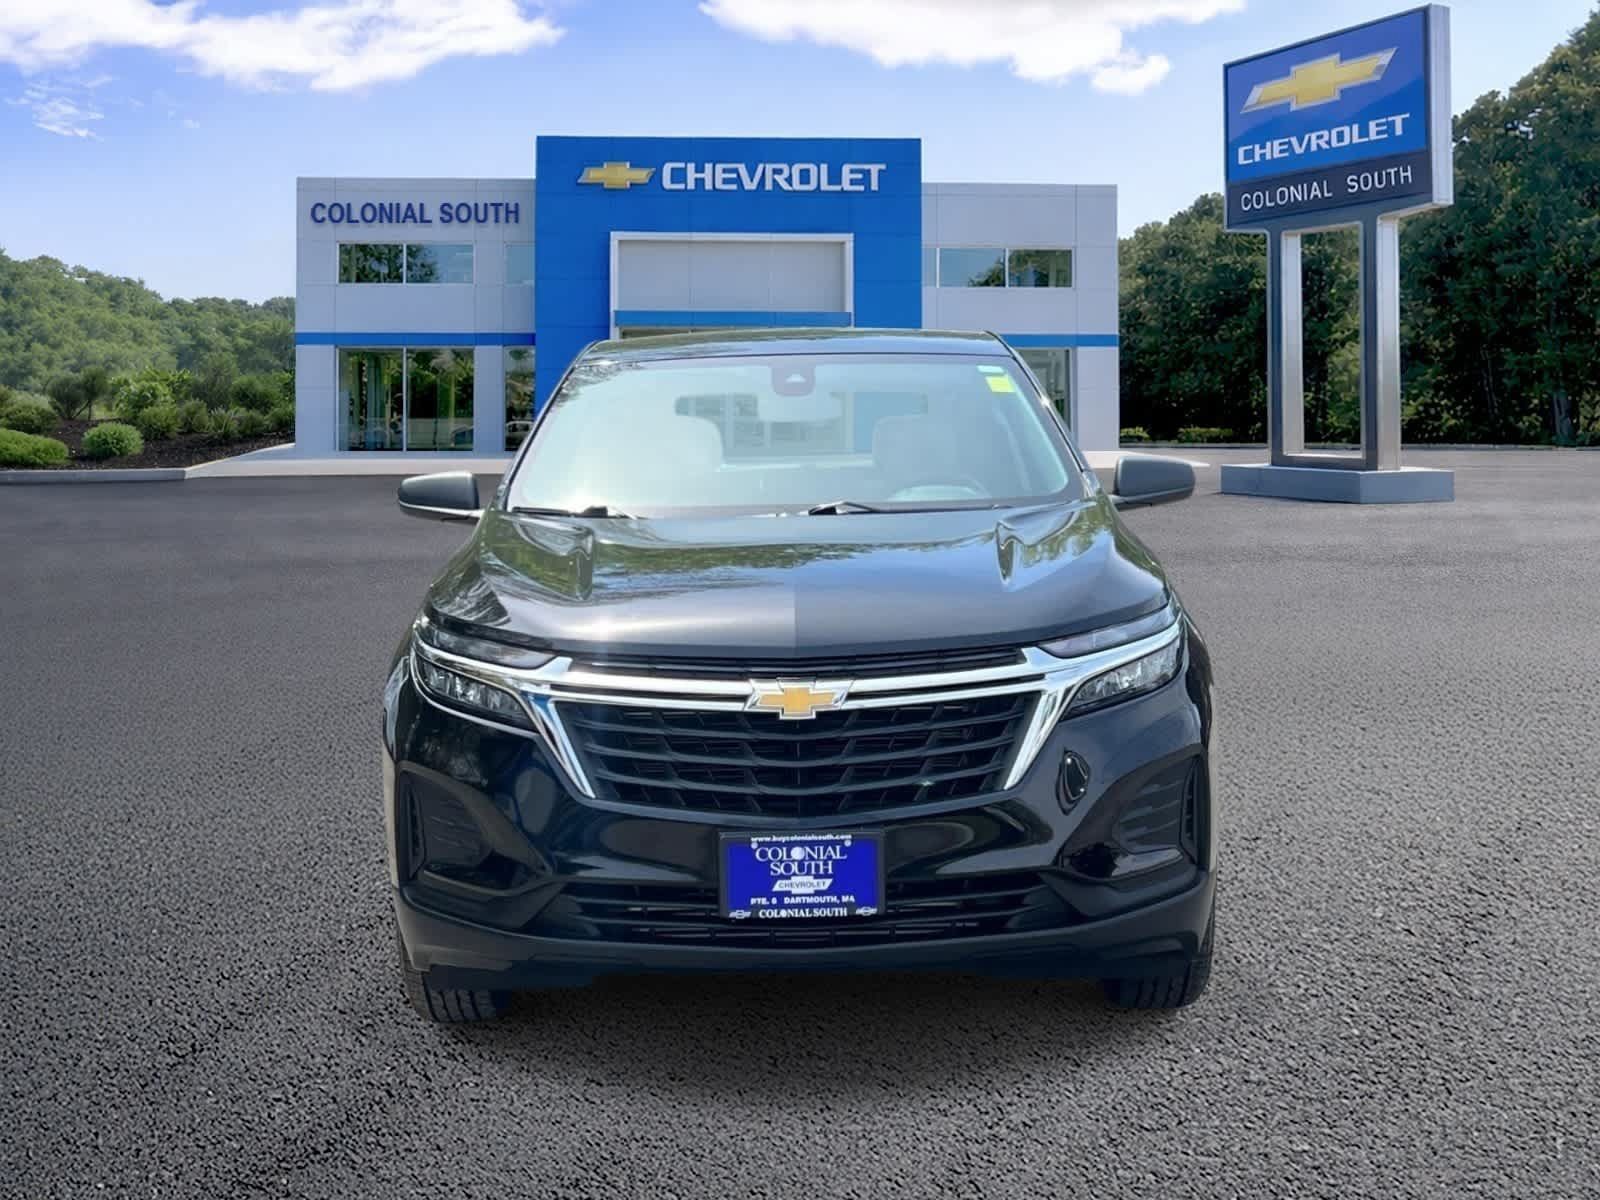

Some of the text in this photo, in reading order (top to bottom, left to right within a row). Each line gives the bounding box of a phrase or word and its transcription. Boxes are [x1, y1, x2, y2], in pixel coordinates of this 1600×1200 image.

[1237, 112, 1410, 165] CHEVROLET
[661, 162, 887, 192] CHEVROLET
[1240, 165, 1413, 211] COLONIAL SOUTH
[310, 202, 521, 225] COLONIAL SOUTH
[751, 834, 852, 843] www.buycolonialsouth.com
[756, 846, 847, 861] COLONIAL
[770, 861, 833, 875] SOUTH
[777, 881, 827, 889] CHEVROLET
[783, 896, 840, 905] DARTMOUTH,
[841, 895, 855, 903] MA
[759, 907, 848, 918] COLONIAL SOUTH
